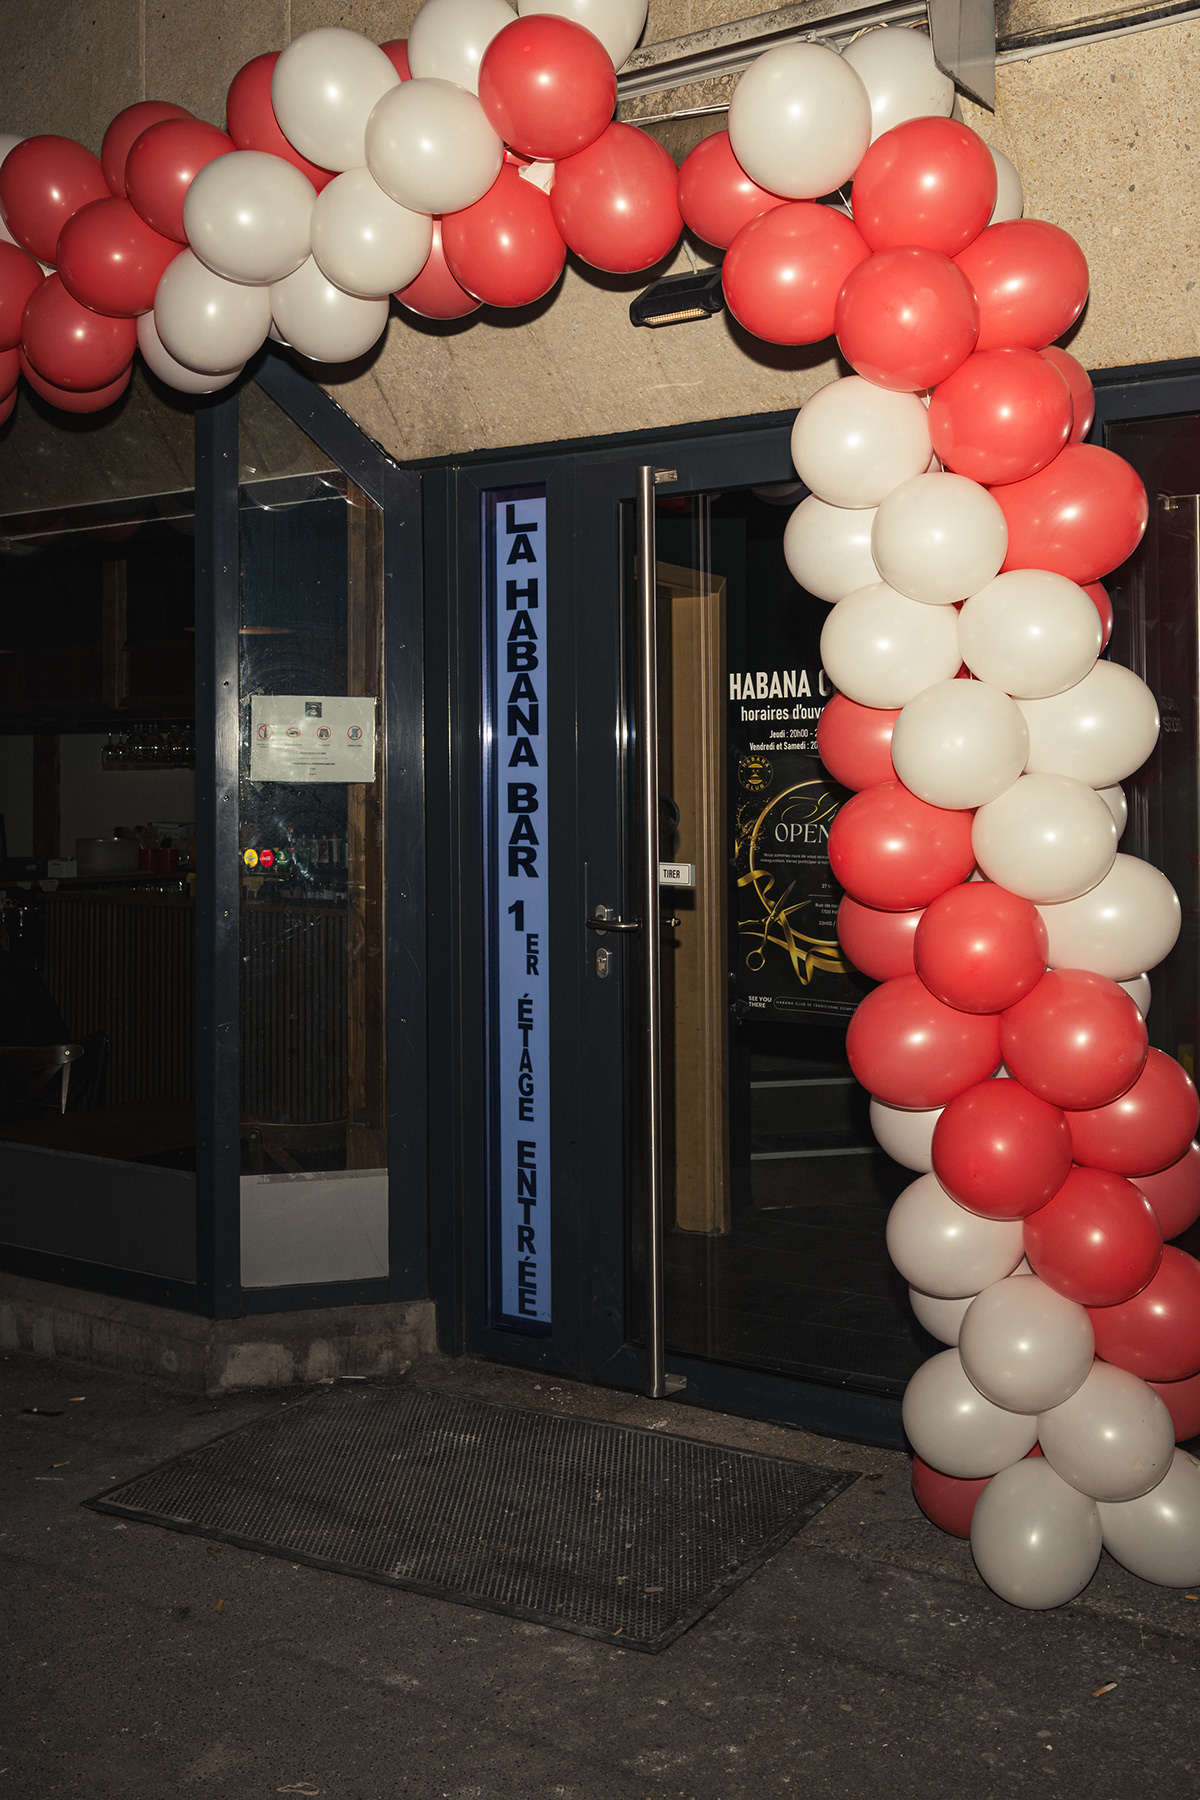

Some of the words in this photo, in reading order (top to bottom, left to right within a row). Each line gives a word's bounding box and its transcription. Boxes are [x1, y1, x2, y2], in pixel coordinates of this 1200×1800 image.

[505, 504, 538, 565] LA
[506, 578, 540, 767] HABANA
[729, 669, 812, 700] HABANA
[741, 705, 789, 721] horaires
[769, 730, 786, 739] Jeudi
[749, 742, 775, 751] Vendredi
[776, 742, 783, 750] et
[783, 741, 806, 750] Samedi
[741, 756, 770, 768] HABANA
[745, 783, 765, 791] CLUB
[507, 782, 540, 878] BAR
[663, 869, 681, 879] TIRER
[748, 1001, 766, 1009] THERE
[517, 993, 535, 1122] ÉTAGE
[517, 1139, 538, 1317] ENTRÉE
